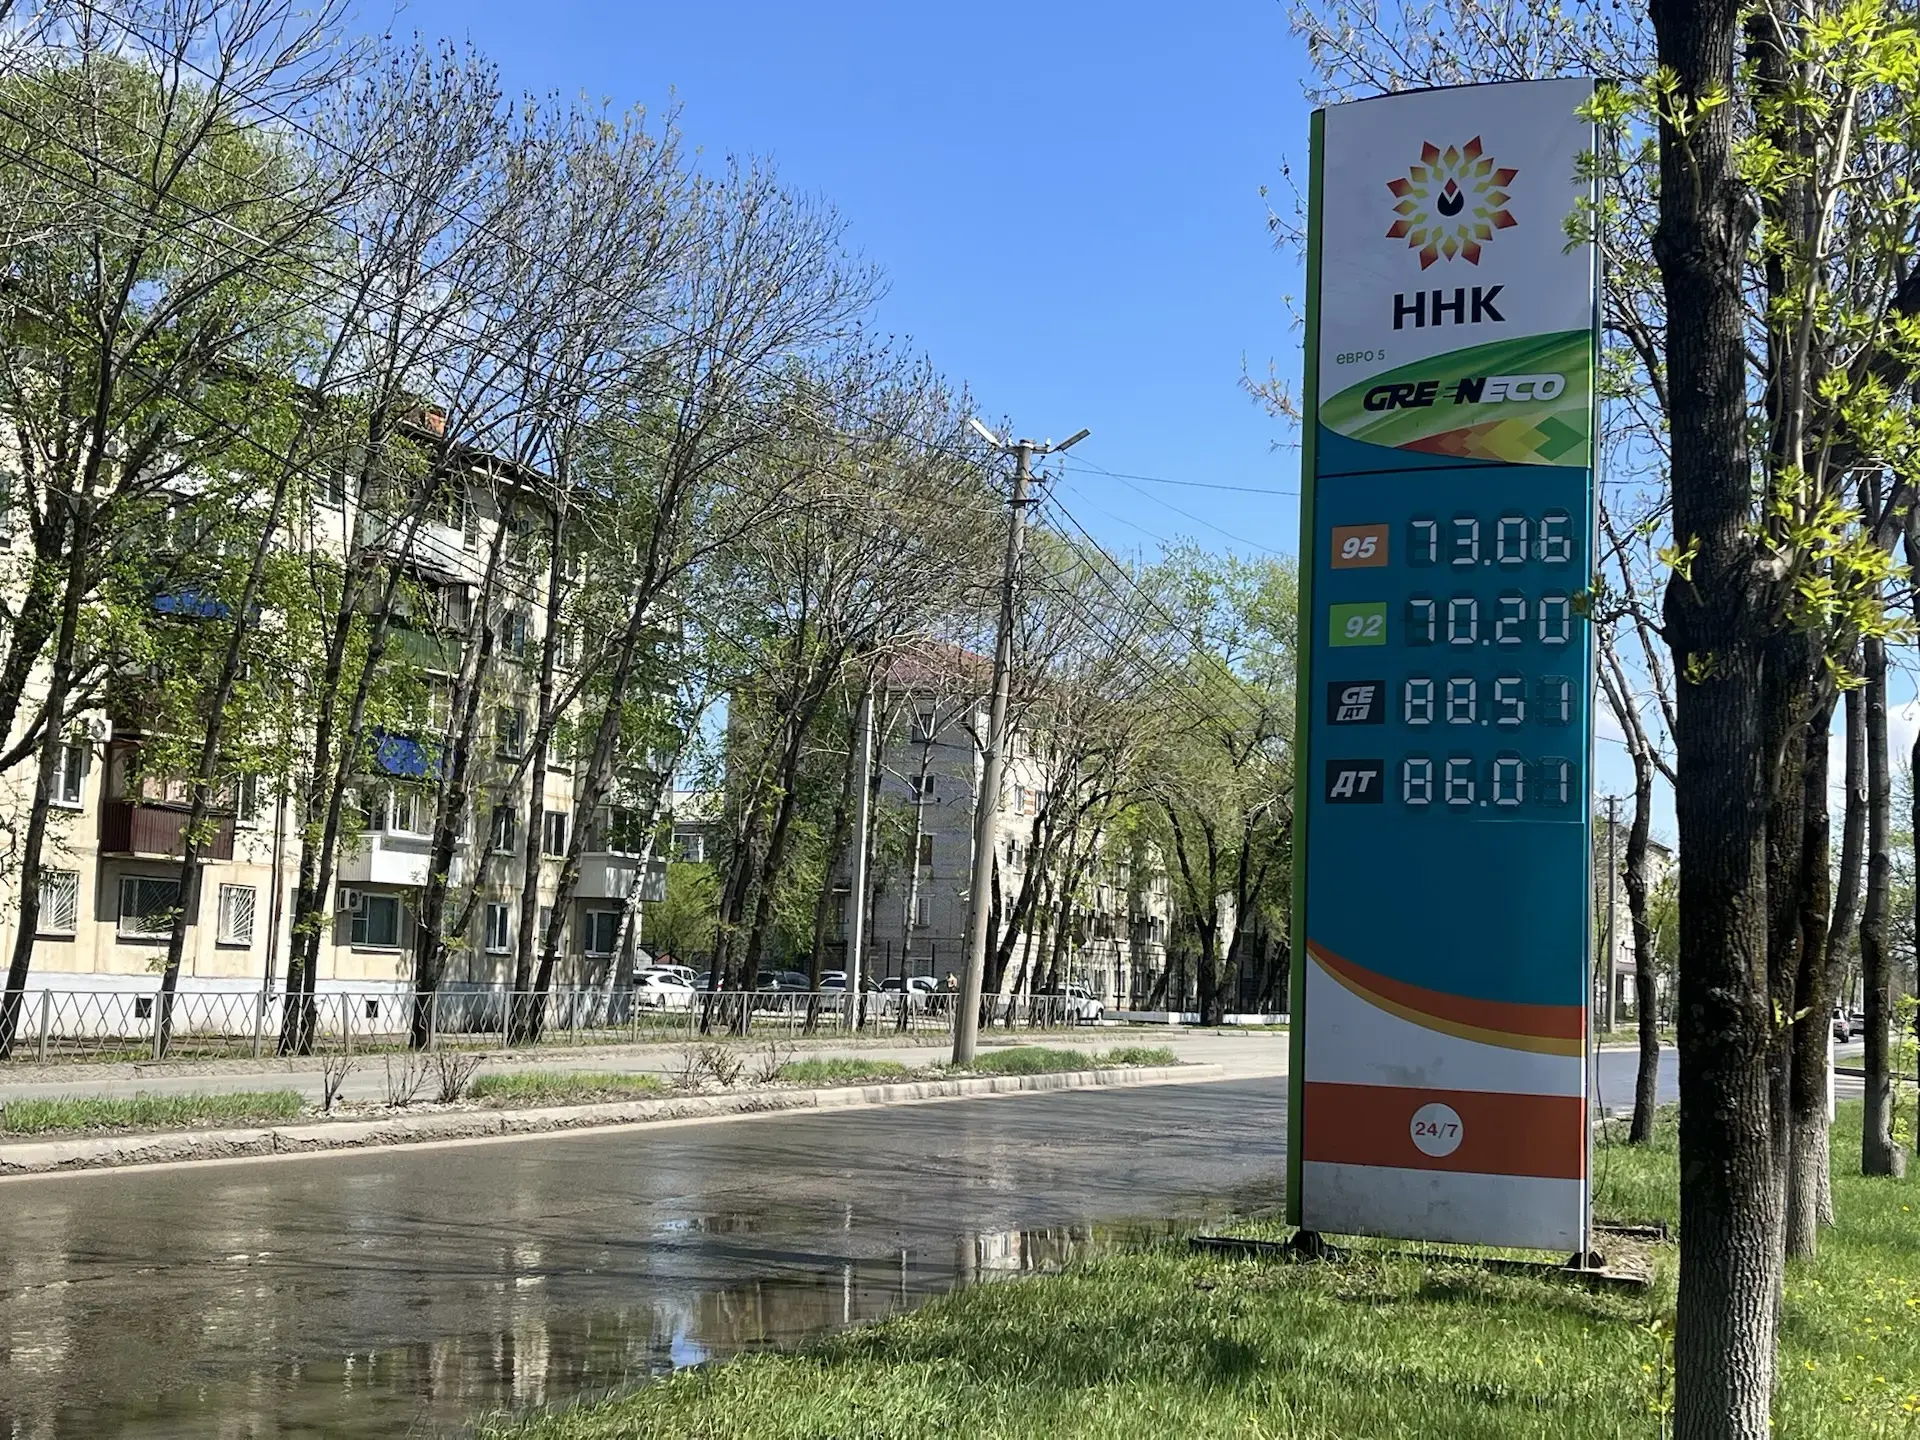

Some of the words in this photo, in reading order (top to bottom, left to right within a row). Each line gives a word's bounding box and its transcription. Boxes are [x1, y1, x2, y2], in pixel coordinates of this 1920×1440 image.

[1393, 284, 1504, 329] ННК
[1377, 350, 1385, 360] 5
[1341, 536, 1378, 558] 95
[1411, 516, 1569, 564] 73.06
[1344, 614, 1382, 637] 92
[1409, 597, 1568, 644] 70.20
[1341, 685, 1375, 704] GE
[1404, 677, 1567, 724] 88.51
[1330, 770, 1375, 797] ДТ
[1403, 758, 1566, 805] 86.01
[1414, 1121, 1458, 1139] 24/7
